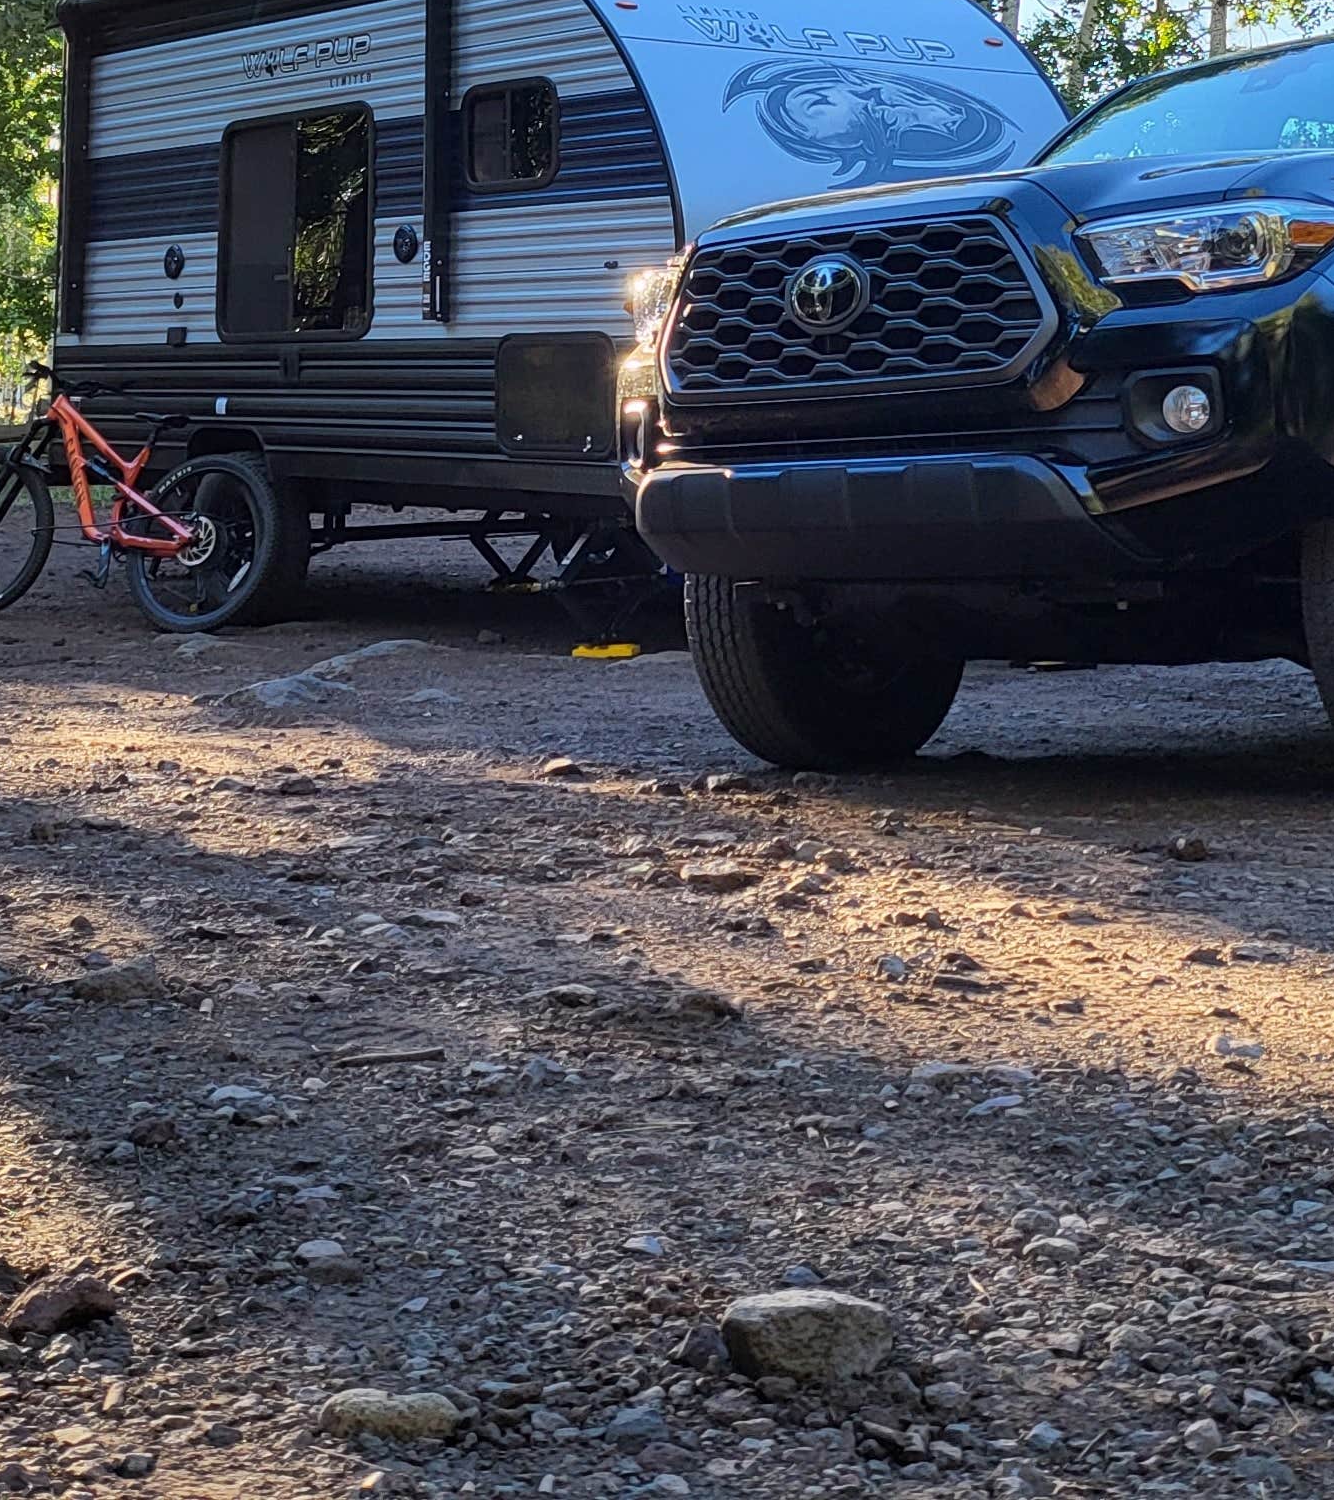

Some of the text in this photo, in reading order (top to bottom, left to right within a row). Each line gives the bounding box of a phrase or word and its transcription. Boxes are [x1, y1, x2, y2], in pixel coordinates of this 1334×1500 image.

[314, 33, 372, 68] PUP
[843, 30, 955, 62] PUP
[423, 240, 432, 282] EDGE
